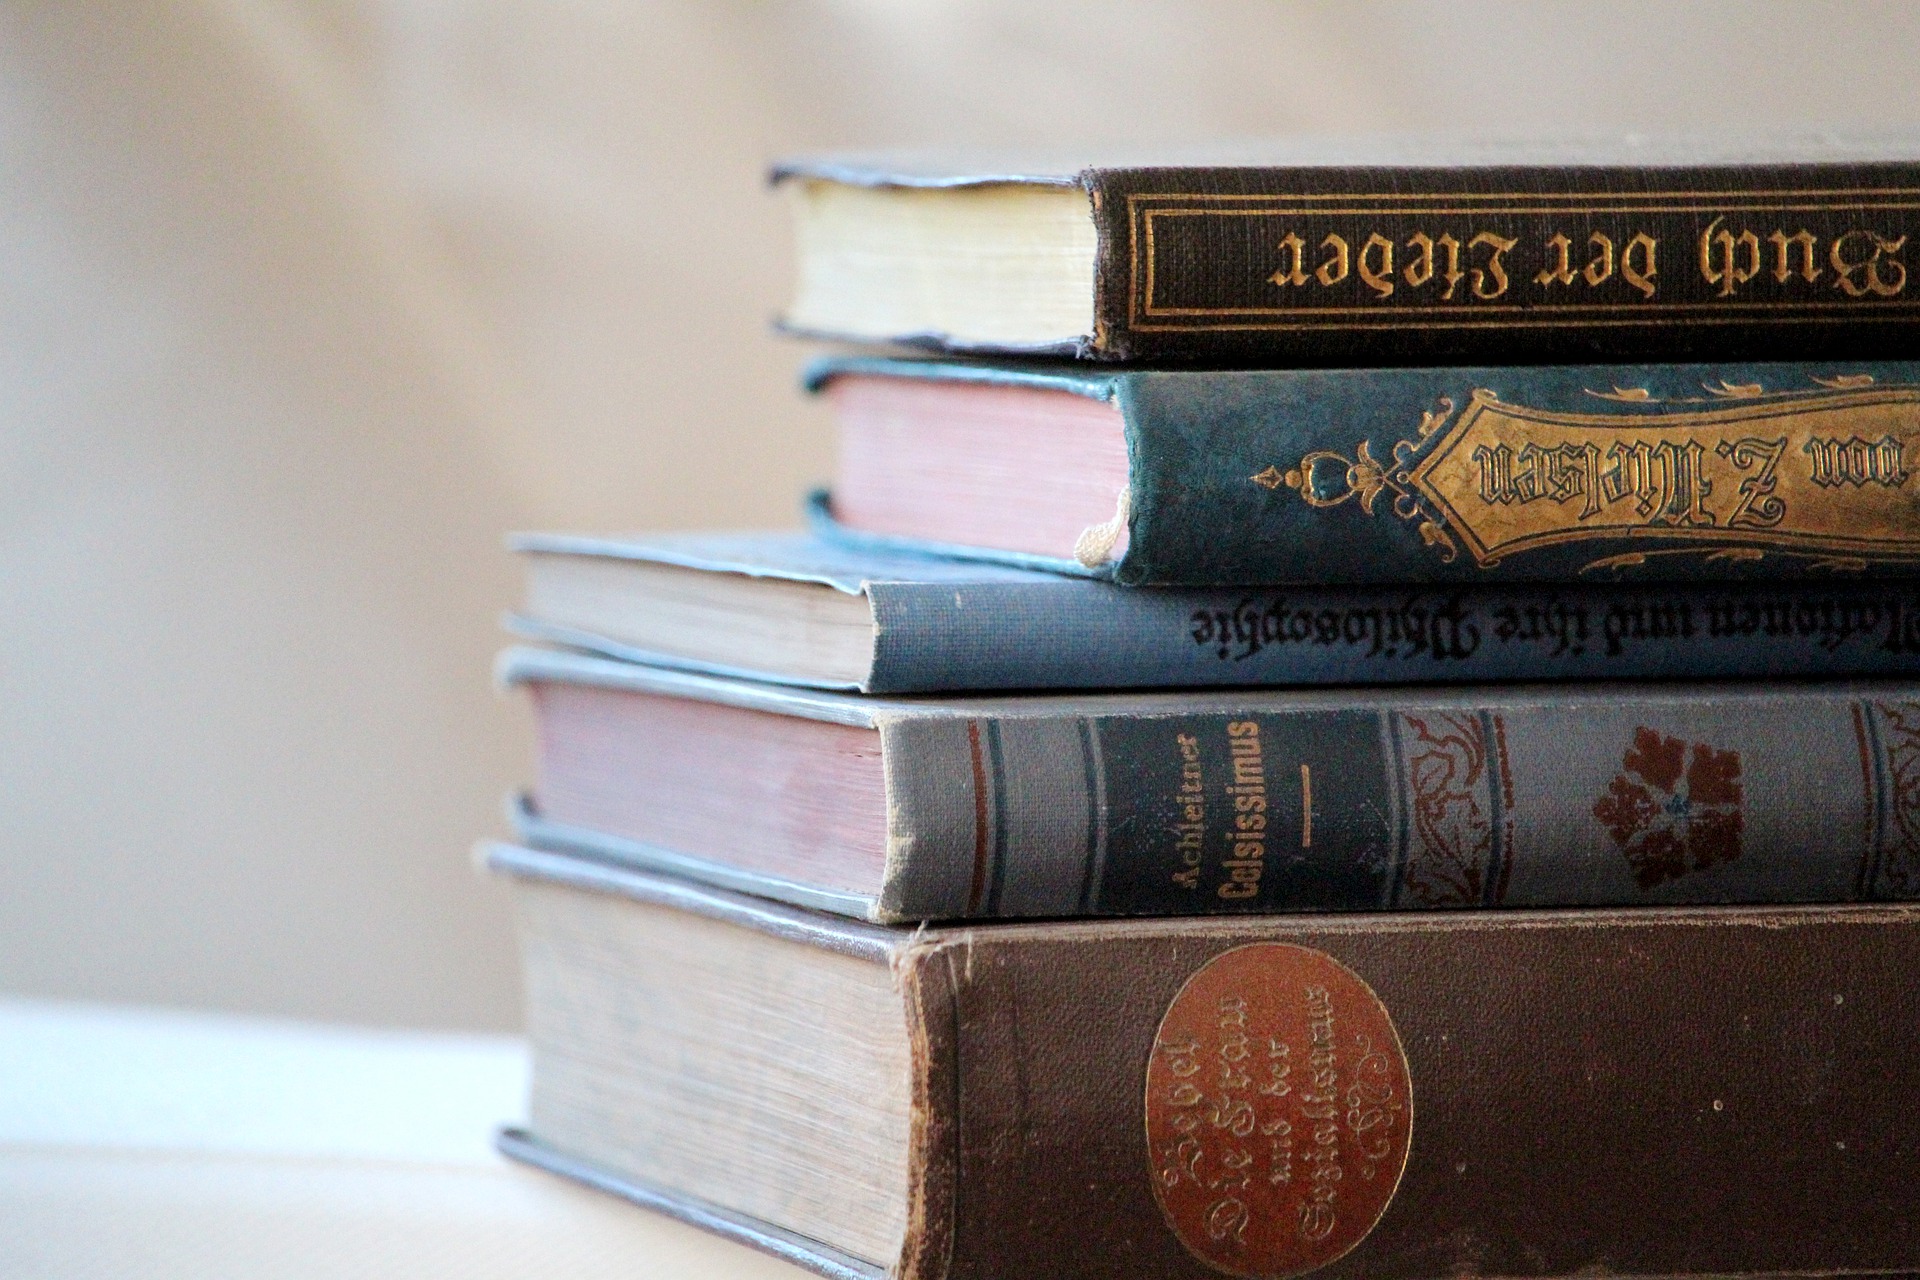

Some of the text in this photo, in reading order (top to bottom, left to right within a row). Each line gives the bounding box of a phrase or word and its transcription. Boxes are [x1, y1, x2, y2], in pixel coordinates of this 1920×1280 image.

[1266, 214, 1907, 301] Buch der Lieder
[1472, 437, 1715, 528] Nielsen
[1802, 435, 1909, 489] von
[1191, 593, 1481, 661] Philosophie
[1494, 593, 1589, 658] ihre
[1604, 602, 1694, 657] und
[1172, 733, 1204, 889] Achleitner
[1217, 721, 1267, 899] Celsissimus
[1204, 997, 1254, 1244] Die Frau
[1258, 1038, 1292, 1185] und der
